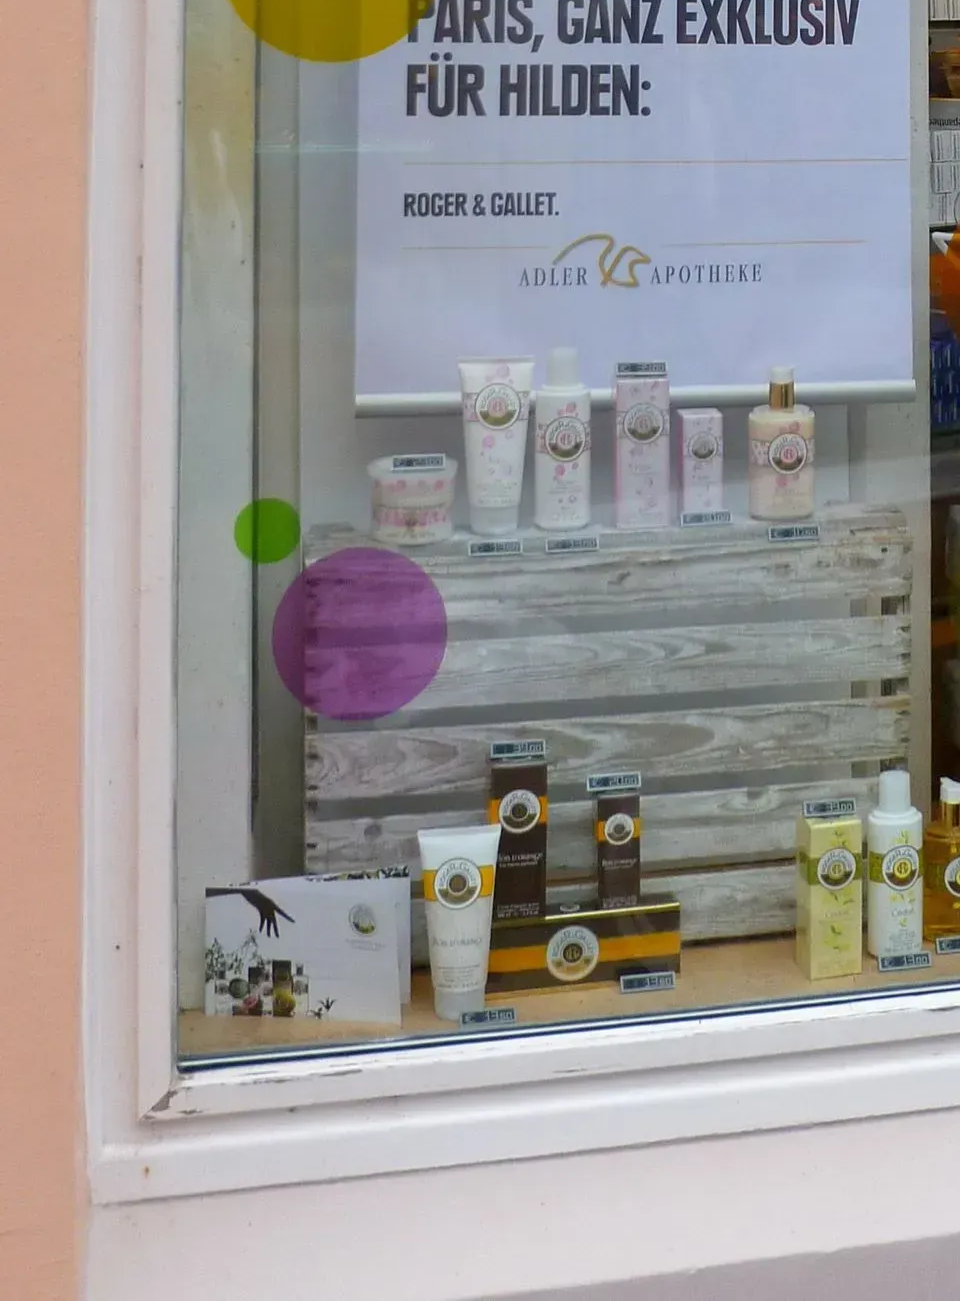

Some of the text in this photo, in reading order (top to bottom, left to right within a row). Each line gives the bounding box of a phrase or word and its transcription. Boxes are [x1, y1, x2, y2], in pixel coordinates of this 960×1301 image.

[405, 52, 652, 117] FÜR HILDEN:
[403, 192, 560, 218] ROGER & GALLET.
[518, 263, 763, 288] ADLER APOTHEKE
